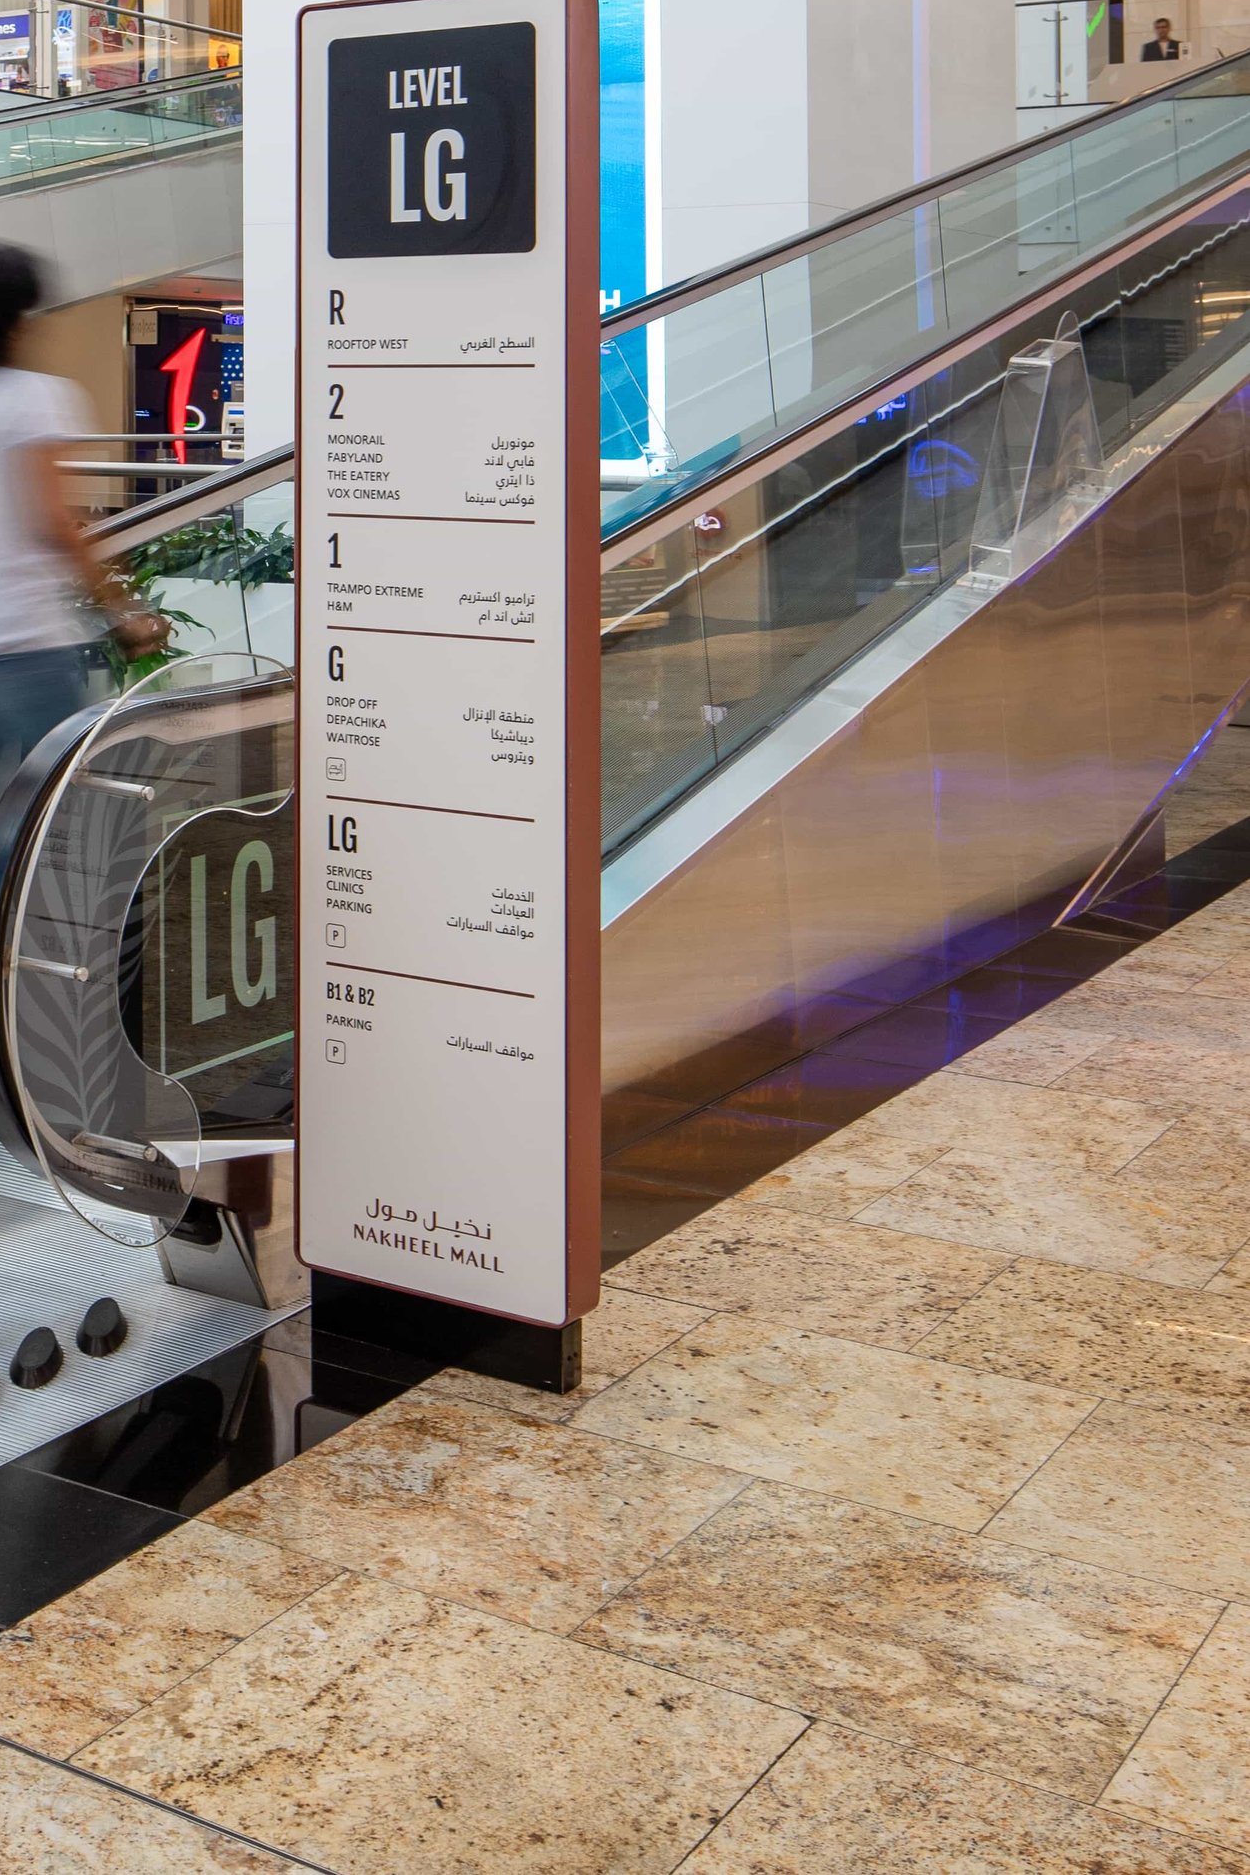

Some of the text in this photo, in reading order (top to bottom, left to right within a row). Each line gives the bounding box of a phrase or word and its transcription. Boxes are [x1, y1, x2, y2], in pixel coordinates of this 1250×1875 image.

[389, 65, 468, 110] LEVEL
[390, 128, 467, 223] LG
[330, 290, 345, 325] R
[328, 339, 408, 349] ROOFTOP WEST
[460, 337, 534, 354] السطح الغربي
[329, 384, 344, 419] 2
[328, 435, 385, 445] MONORAIL
[491, 437, 534, 450] مونوريل
[328, 452, 383, 463] FABYLAND
[485, 455, 534, 471] فابي لاند
[327, 470, 390, 481] THE EATERY
[496, 474, 535, 490] ذا ايتري
[327, 488, 400, 500] VOX CINEMAS
[465, 492, 534, 507] فوكس سينما
[328, 533, 342, 568] 1
[327, 583, 423, 598] TRAMPO EXTREME
[328, 601, 352, 611] H&M
[459, 592, 535, 607] ترامبو اكستريم
[479, 610, 534, 625] اتش اند ام
[328, 645, 344, 682] G
[327, 696, 377, 709] DROP OFF
[327, 714, 386, 729] DEPACHIKA
[463, 708, 534, 724] منطقة الإنزال
[326, 732, 380, 747] WAITROSE
[491, 729, 534, 745] ديباشيكا
[491, 752, 534, 765] ويتروس
[328, 815, 357, 853] LG
[326, 865, 372, 880] SERVICES
[326, 880, 364, 894] CLINICS
[492, 888, 534, 903] الخدمات
[327, 898, 372, 914] PARKING
[491, 904, 534, 919] العيادات
[190, 839, 277, 1025] LG
[447, 917, 534, 939] مواقف السيارات
[327, 982, 374, 1006] B1 & B2
[327, 1014, 372, 1031] PARKING
[447, 1036, 534, 1061] مواقف السيارات
[366, 1198, 491, 1240] نخيل مول
[354, 1223, 504, 1273] NAKHEEL MALL
